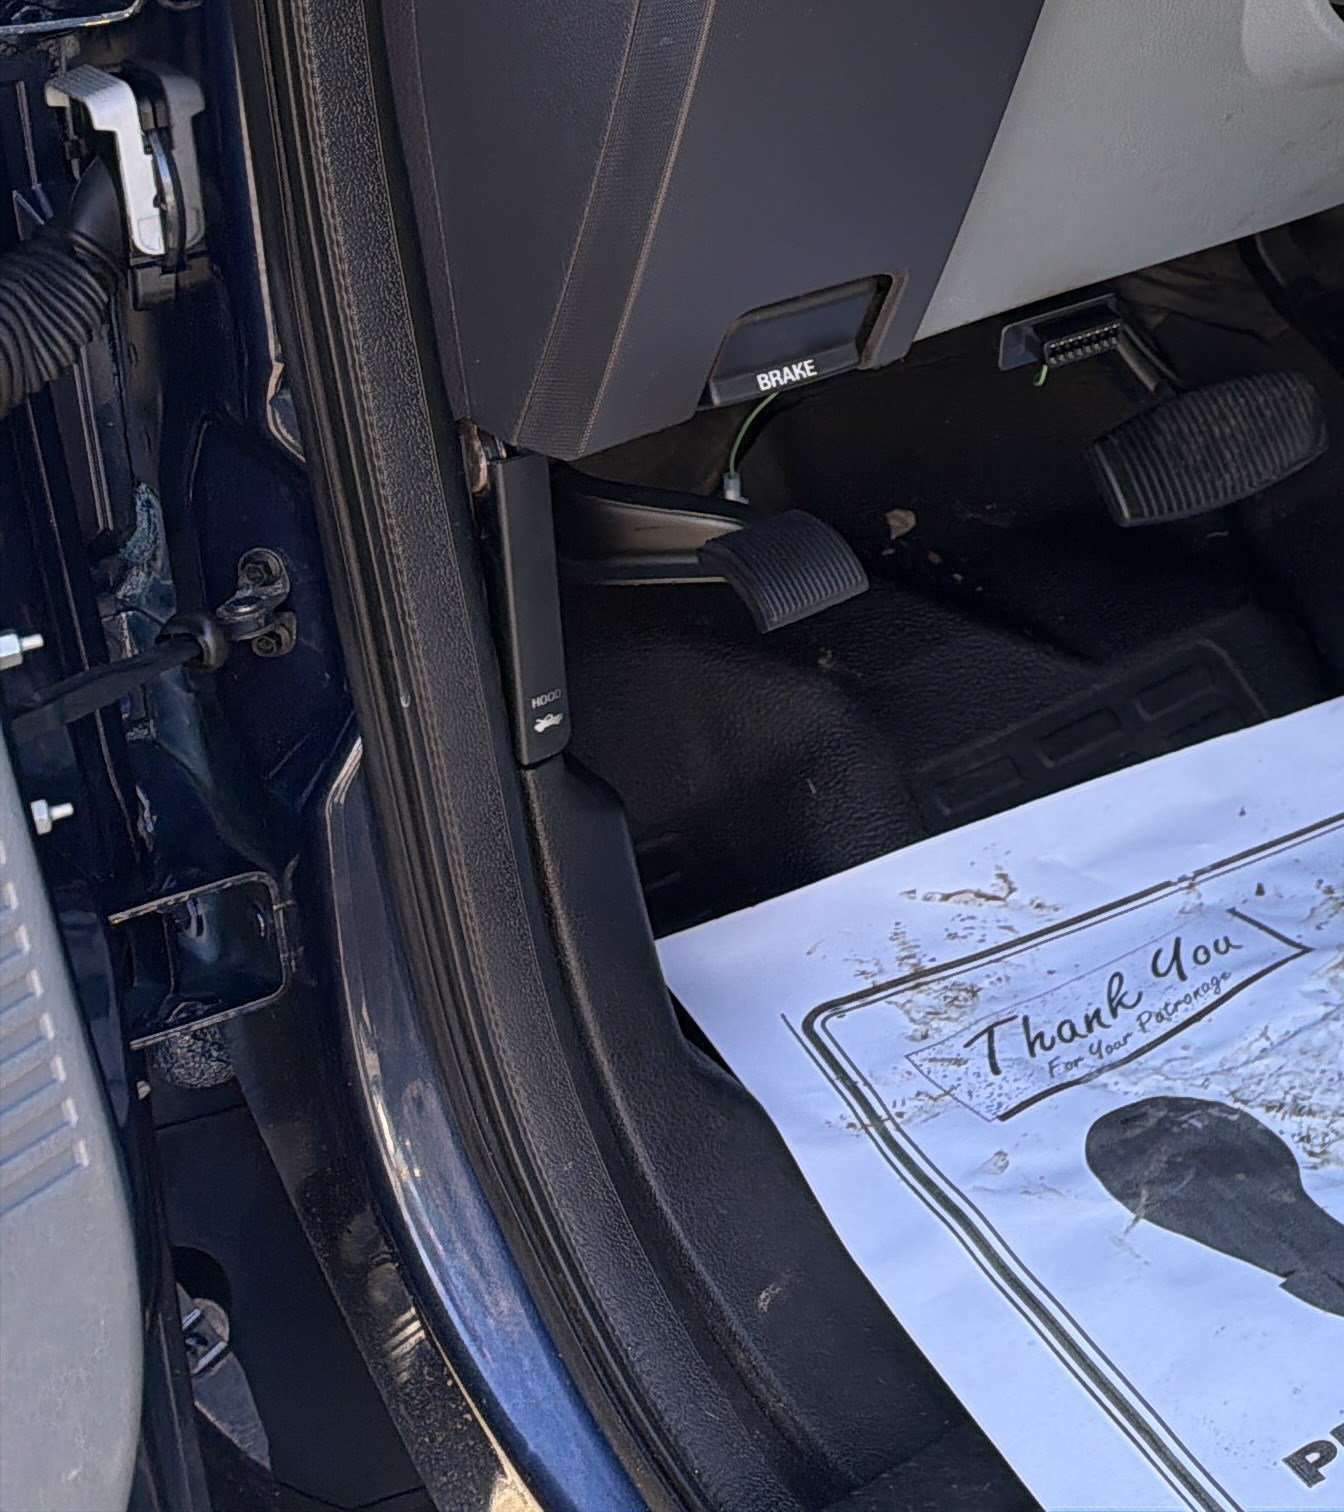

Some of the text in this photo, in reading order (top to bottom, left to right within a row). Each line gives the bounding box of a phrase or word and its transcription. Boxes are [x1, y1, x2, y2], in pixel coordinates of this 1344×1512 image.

[756, 359, 818, 391] BRAKE
[531, 688, 562, 709] HOOD
[963, 936, 1243, 1076] Thank You
[1048, 970, 1233, 1078] For Your Patronage
